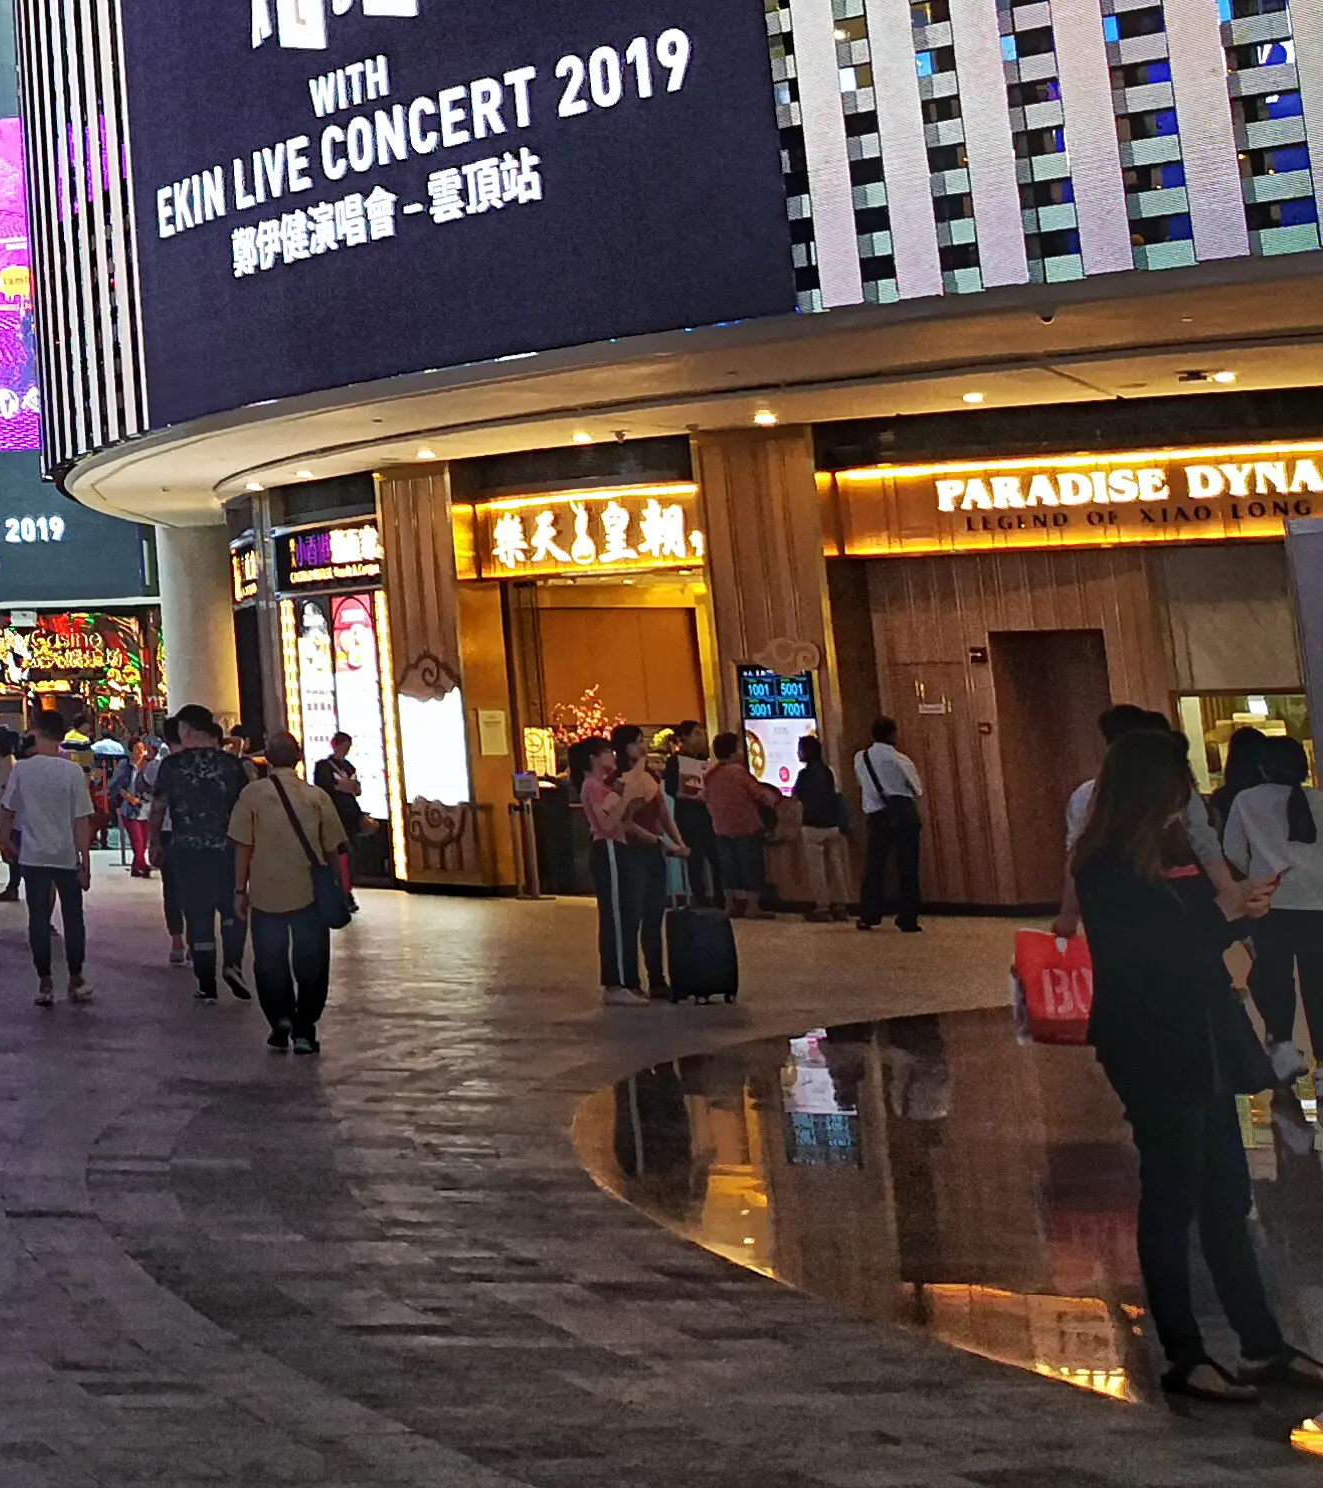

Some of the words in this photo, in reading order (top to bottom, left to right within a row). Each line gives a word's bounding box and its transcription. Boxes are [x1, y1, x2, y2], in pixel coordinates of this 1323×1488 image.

[308, 54, 390, 118] WITH
[156, 165, 227, 239] EKIN
[232, 135, 315, 210] LIVE
[320, 66, 537, 183] CONCERT
[555, 28, 693, 118] 2019
[934, 468, 1171, 512] PARADISE
[4, 515, 66, 544] 2019
[965, 512, 1069, 532] LEGEND
[1087, 510, 1119, 527] OF
[1139, 505, 1212, 524] XIAO
[1231, 498, 1313, 520] LONG
[747, 683, 770, 696] 1001
[780, 682, 804, 696] 5001
[748, 703, 772, 716] 3001
[782, 703, 806, 716] 7001
